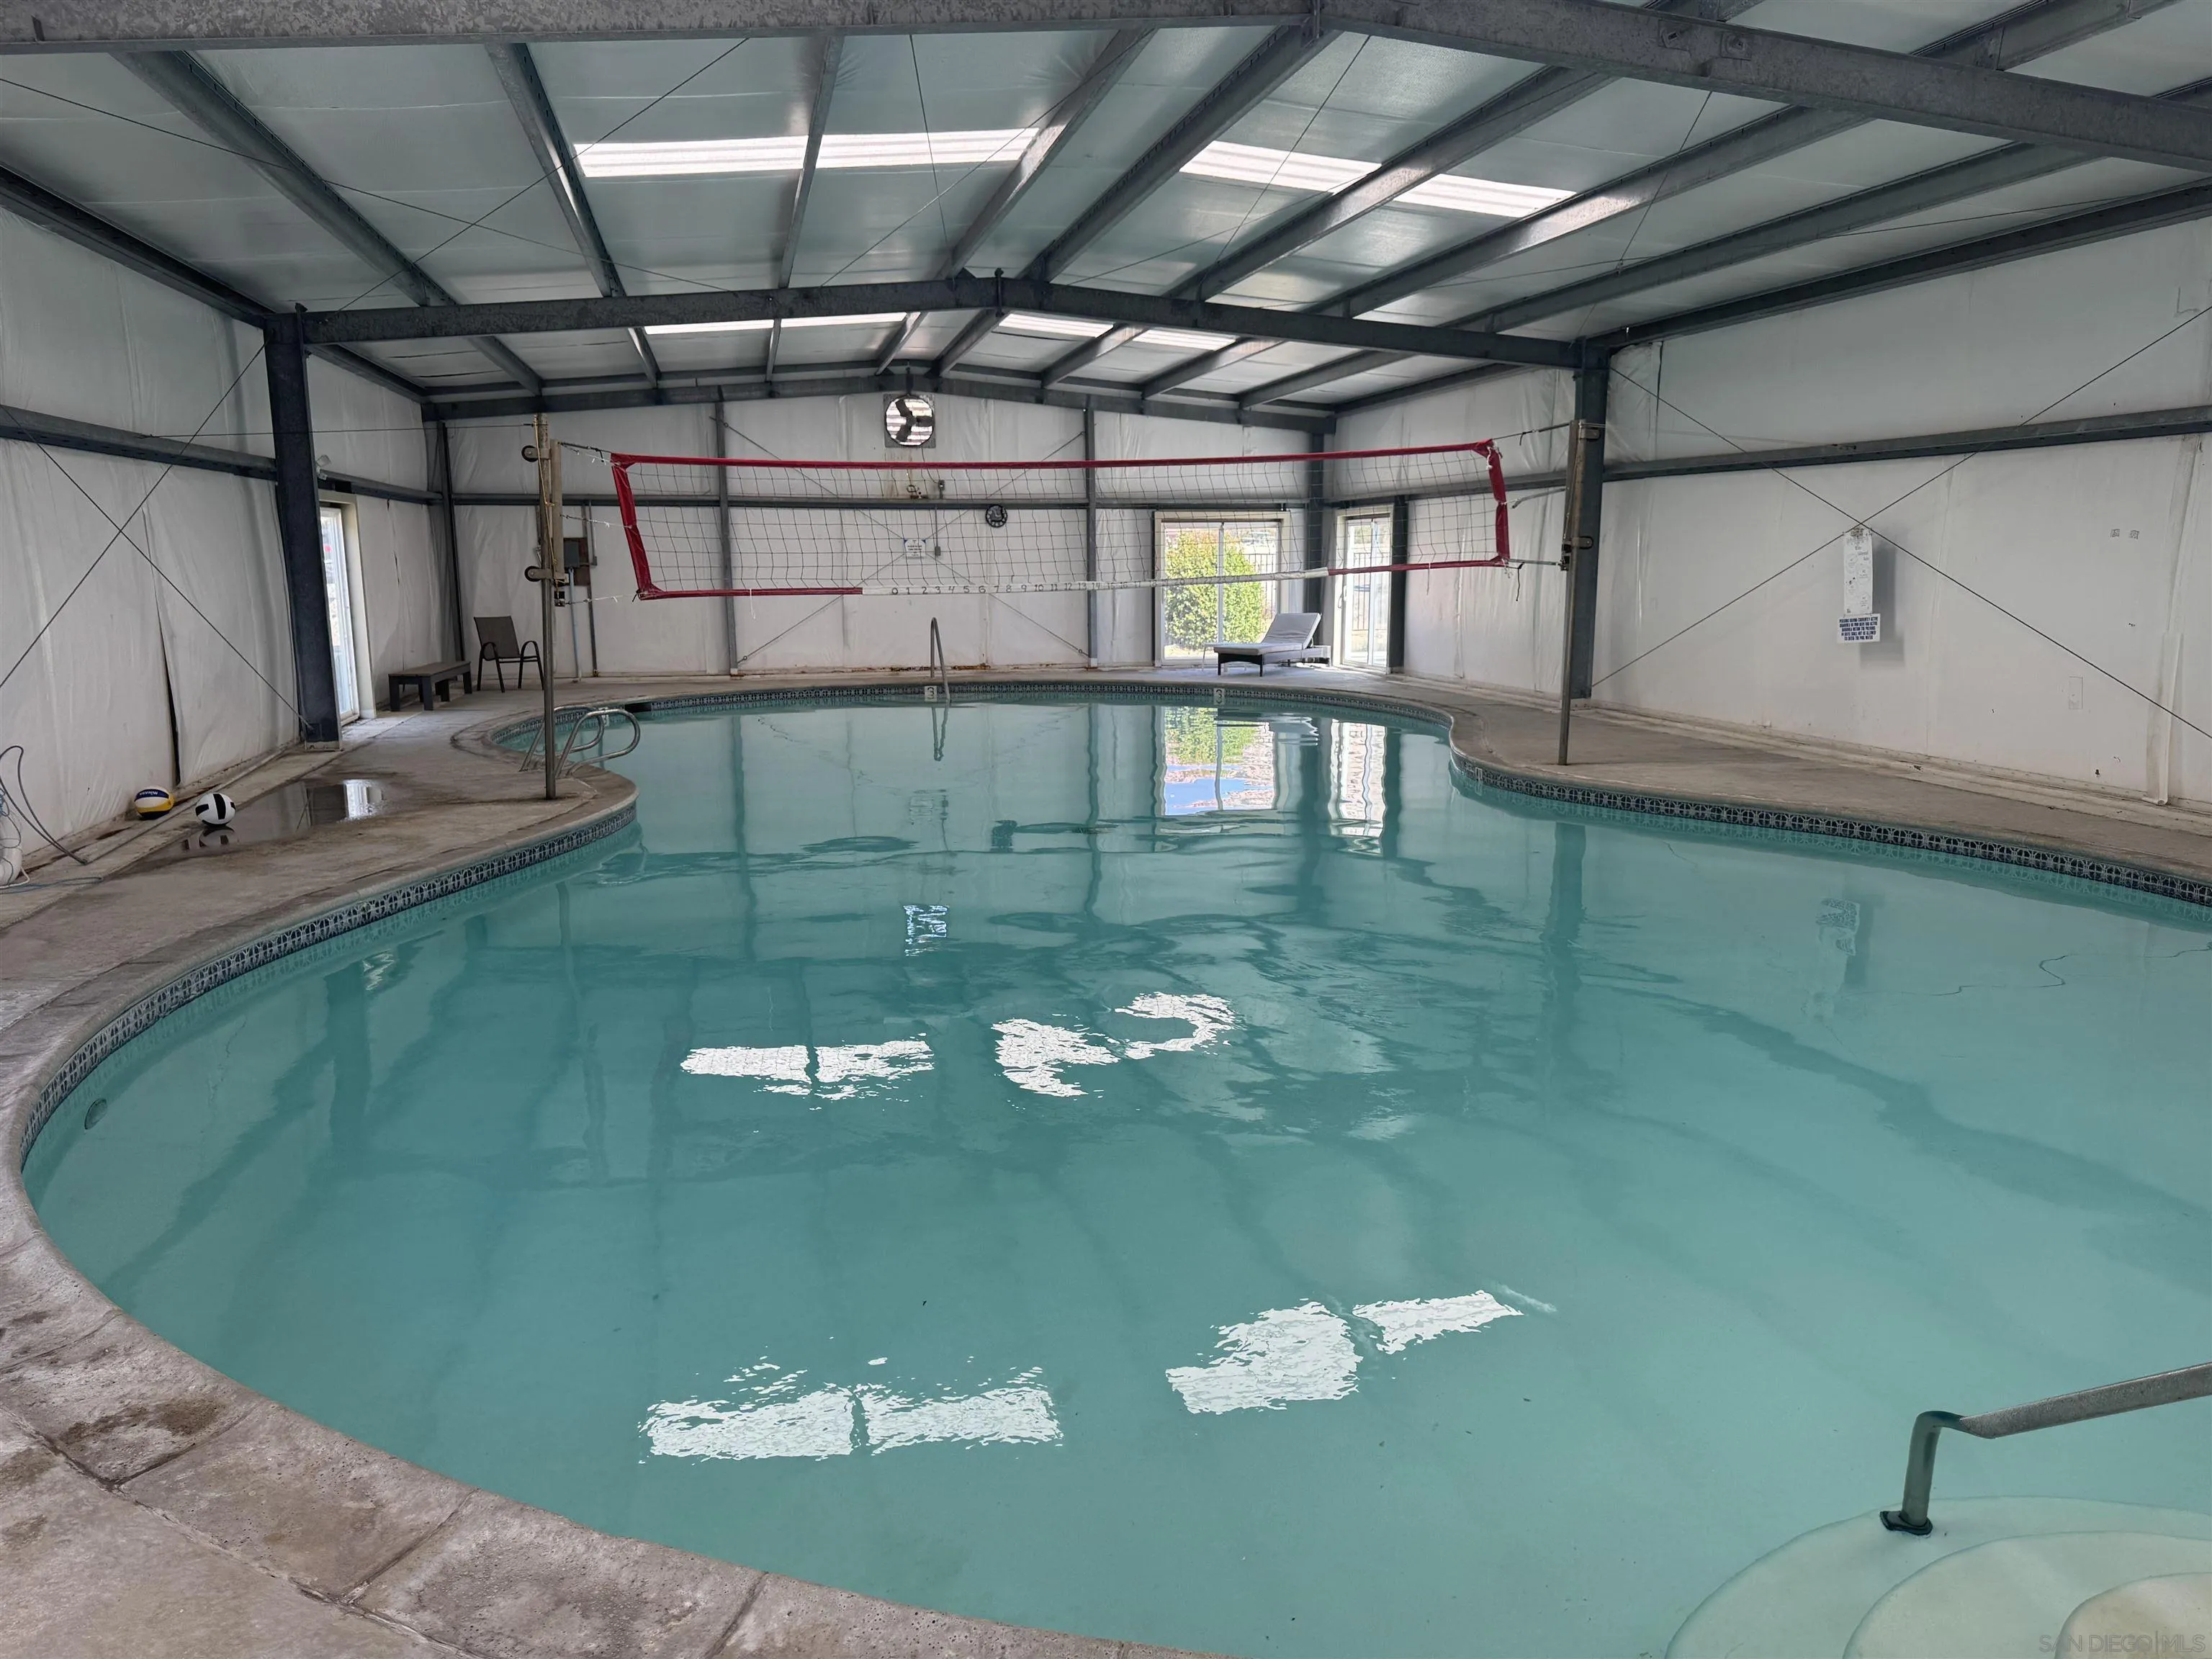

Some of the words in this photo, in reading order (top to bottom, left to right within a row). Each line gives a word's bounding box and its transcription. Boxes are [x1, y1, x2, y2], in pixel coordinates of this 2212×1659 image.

[921, 586, 928, 595] 2
[935, 585, 941, 594] 3
[994, 585, 999, 593] 7
[1020, 584, 1027, 593] 9
[1091, 582, 1100, 590] 14
[927, 687, 934, 697] 3
[1216, 689, 1223, 699] 3
